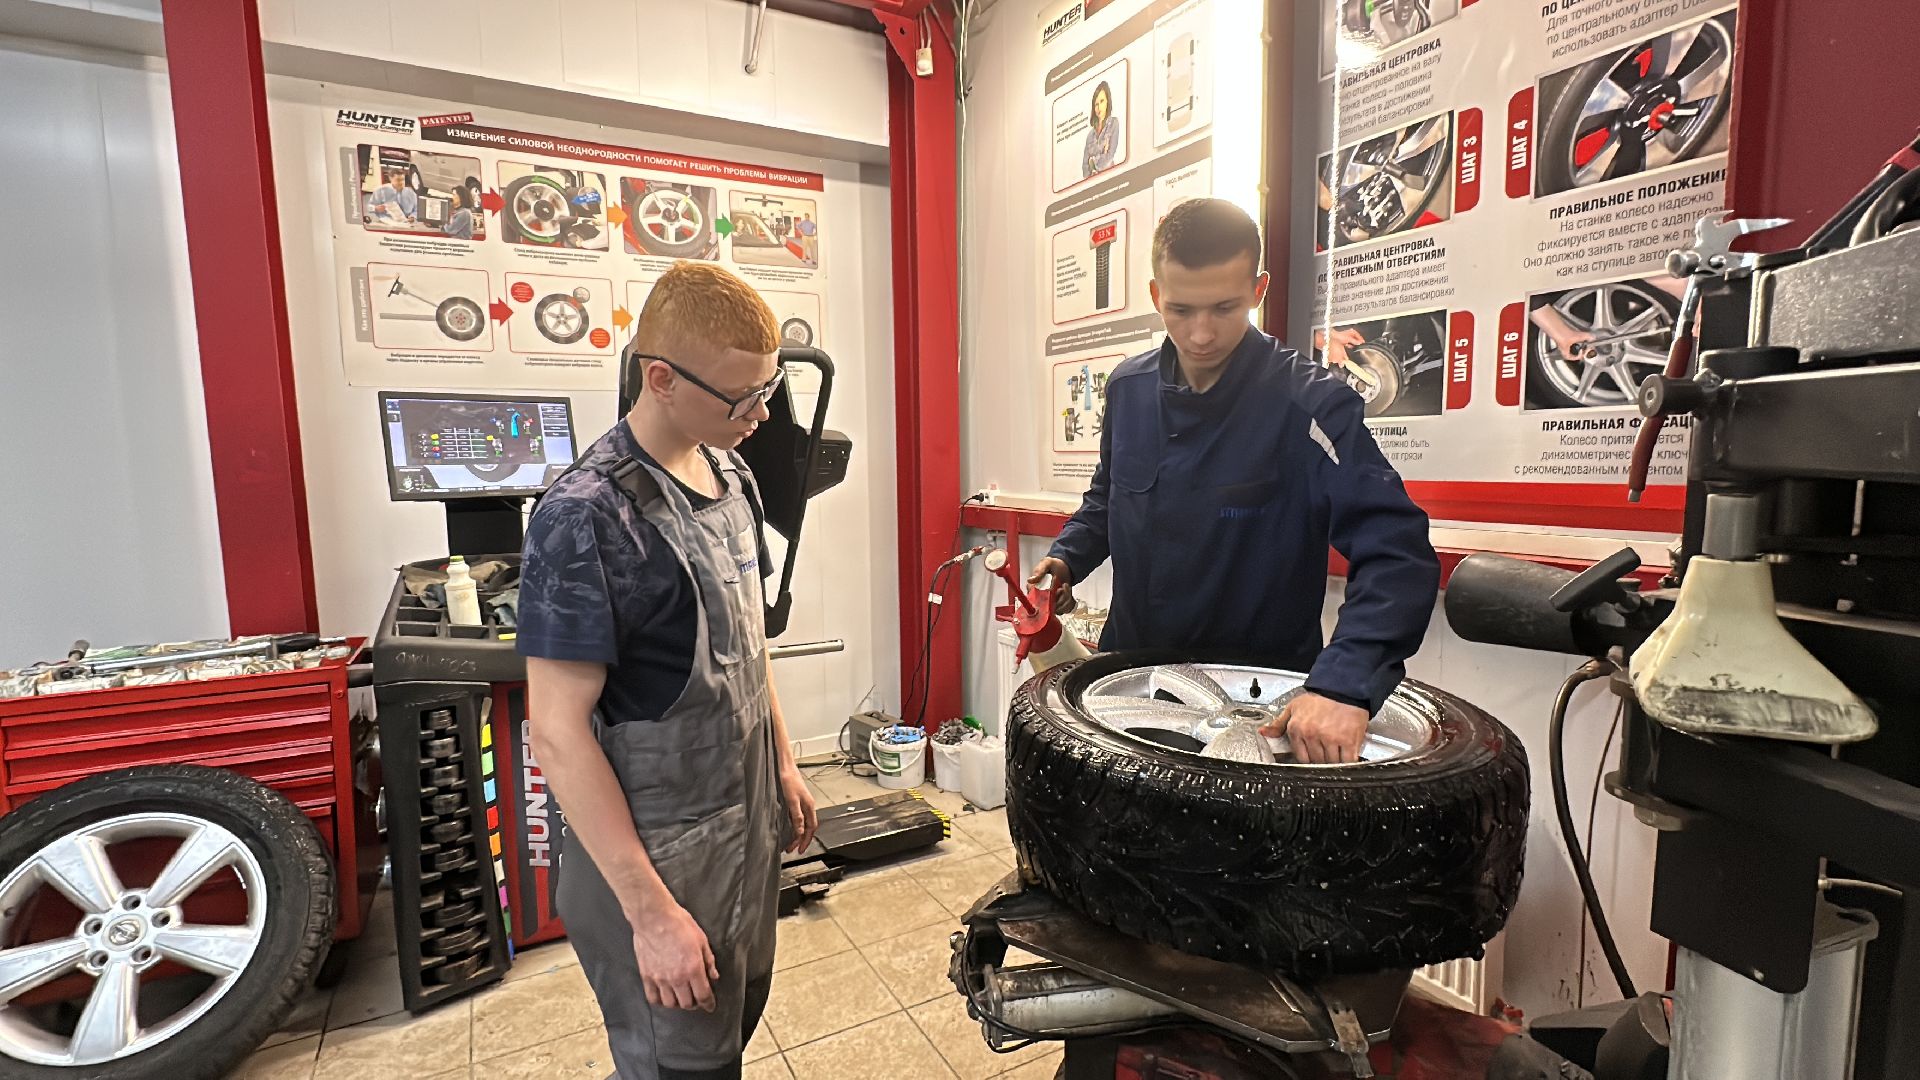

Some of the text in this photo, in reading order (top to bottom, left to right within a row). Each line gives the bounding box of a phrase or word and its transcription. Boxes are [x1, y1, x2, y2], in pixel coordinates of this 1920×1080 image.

[1043, 3, 1082, 38] HUNTER
[1546, 13, 1568, 32] Для
[1546, 4, 1640, 47] по центральному
[1551, 23, 1627, 58] использовать
[1629, 3, 1678, 29] адаптер
[1388, 37, 1441, 69] ЦЕНТРОВКА
[336, 118, 414, 134] Engineering Company
[337, 109, 415, 129] HUNTER
[421, 114, 471, 127] PATENTED
[1512, 119, 1528, 170] ШАГ 4
[447, 128, 808, 185] ИЗМЕРЕНИЕ СИЛОВОЙ НЕОДНОРОДНОСТИ ПОМОГАЕТ РЕШИТЬ ПРОБЛЕМЫ ВИБРАЦИИ
[1461, 135, 1477, 184] ШАГ 3
[1549, 190, 1634, 220] ПРАВИЛЬНОЕ
[1560, 191, 1714, 232] На станке колесо надежно
[1537, 229, 1605, 253] фиксируется
[1608, 221, 1648, 238] вместе
[1651, 218, 1658, 229] с
[1333, 237, 1435, 268] РАВИЛЬНАЯ ЦЕНТРОВКА
[1387, 247, 1446, 268] ОТВЕРСТИЯМ
[1523, 257, 1543, 269] Оно
[1544, 249, 1586, 266] должно
[1587, 242, 1624, 257] занять
[1628, 234, 1659, 249] такое
[1662, 230, 1680, 242] же
[1385, 268, 1420, 282] адаптера
[1421, 263, 1447, 275] имеет
[1556, 266, 1573, 277] как
[1576, 263, 1589, 274] на
[1591, 254, 1636, 272] ступице
[1385, 285, 1400, 296] для
[1400, 275, 1449, 292] достижения
[1399, 287, 1455, 304] балансировки
[1453, 338, 1469, 383] ШАГ 5
[1502, 331, 1519, 378] ШАГ 6
[1542, 416, 1694, 431] ПРАВИЛЬНАЯ ФСАЦ
[1410, 438, 1430, 448] быть
[1560, 434, 1598, 446] Колесо
[1391, 452, 1399, 460] от
[1400, 452, 1423, 462] грязи
[1541, 450, 1689, 463] динамометричес ключ
[1514, 465, 1682, 476] с рекомендованным ментом
